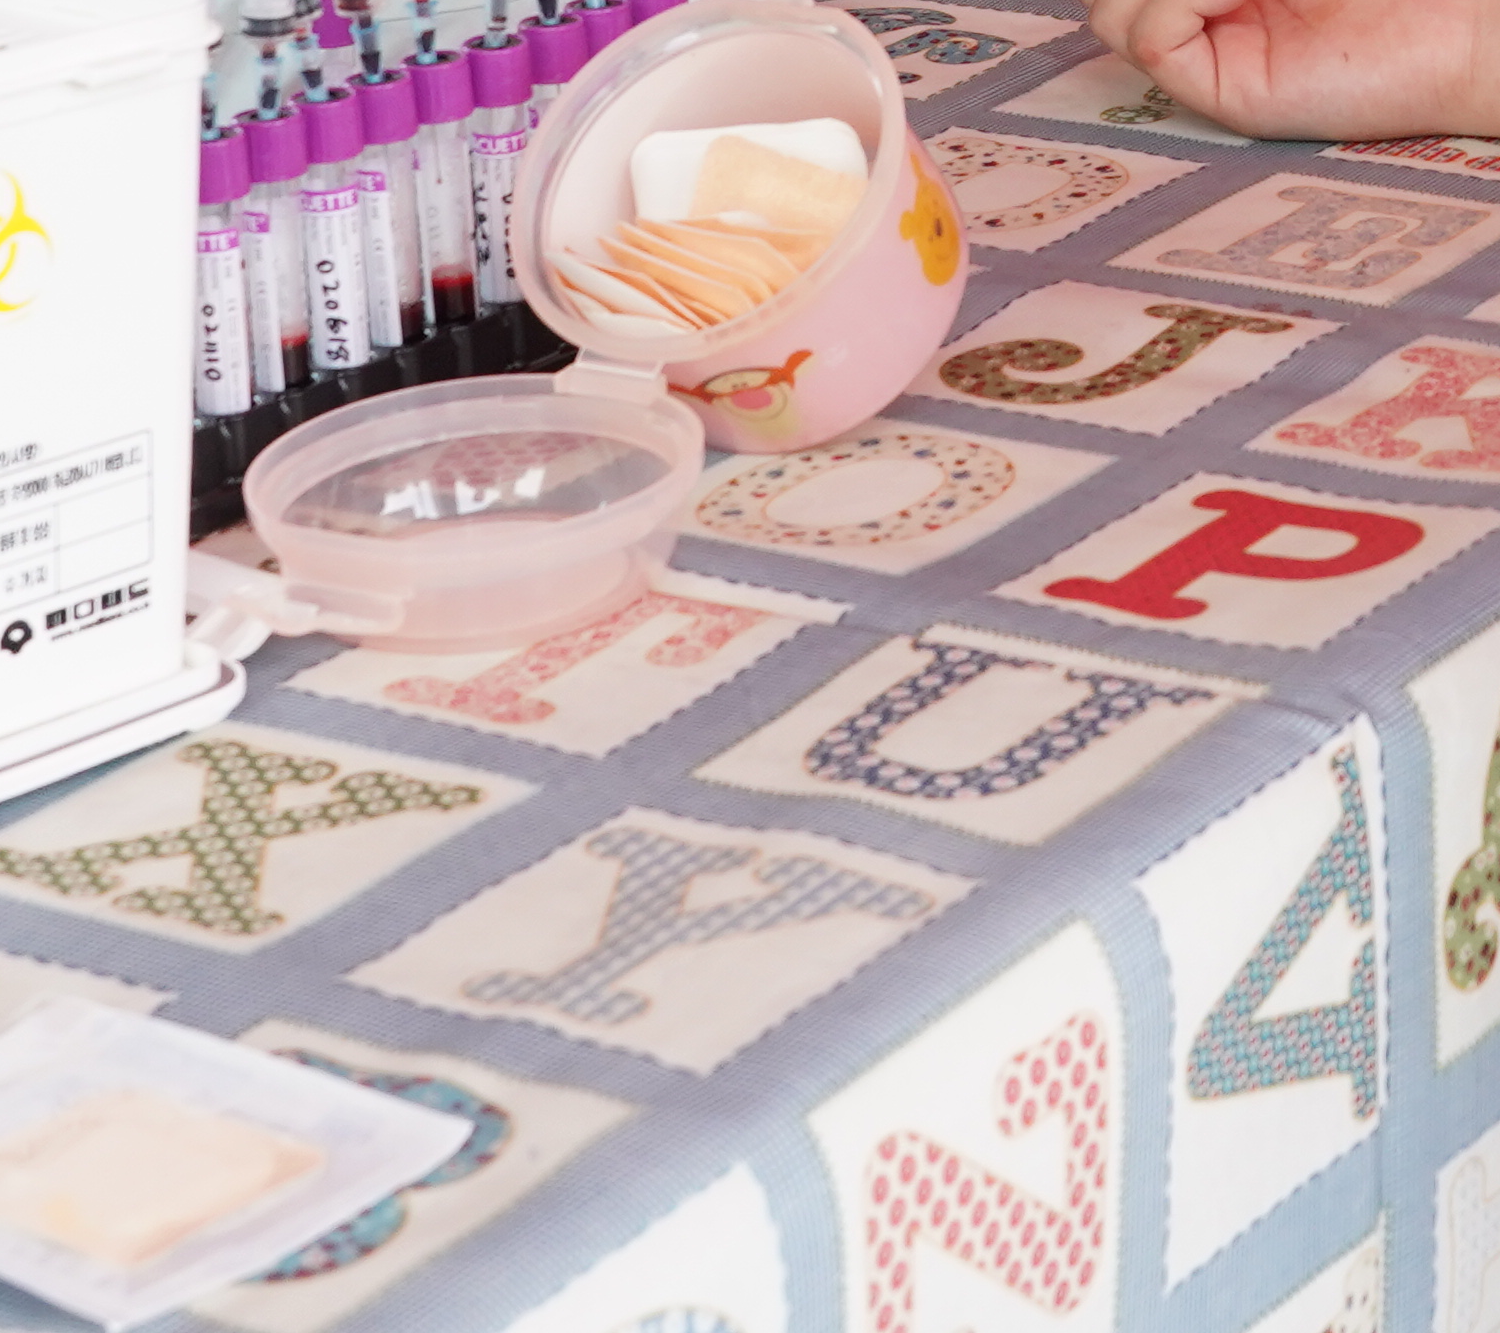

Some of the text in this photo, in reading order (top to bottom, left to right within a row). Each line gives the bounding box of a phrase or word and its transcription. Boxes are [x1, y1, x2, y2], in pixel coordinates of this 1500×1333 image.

[1157, 184, 1493, 290] E
[938, 303, 1296, 406] J
[1043, 488, 1426, 621] P
[803, 637, 1219, 801] U
[461, 825, 939, 1028] Y
